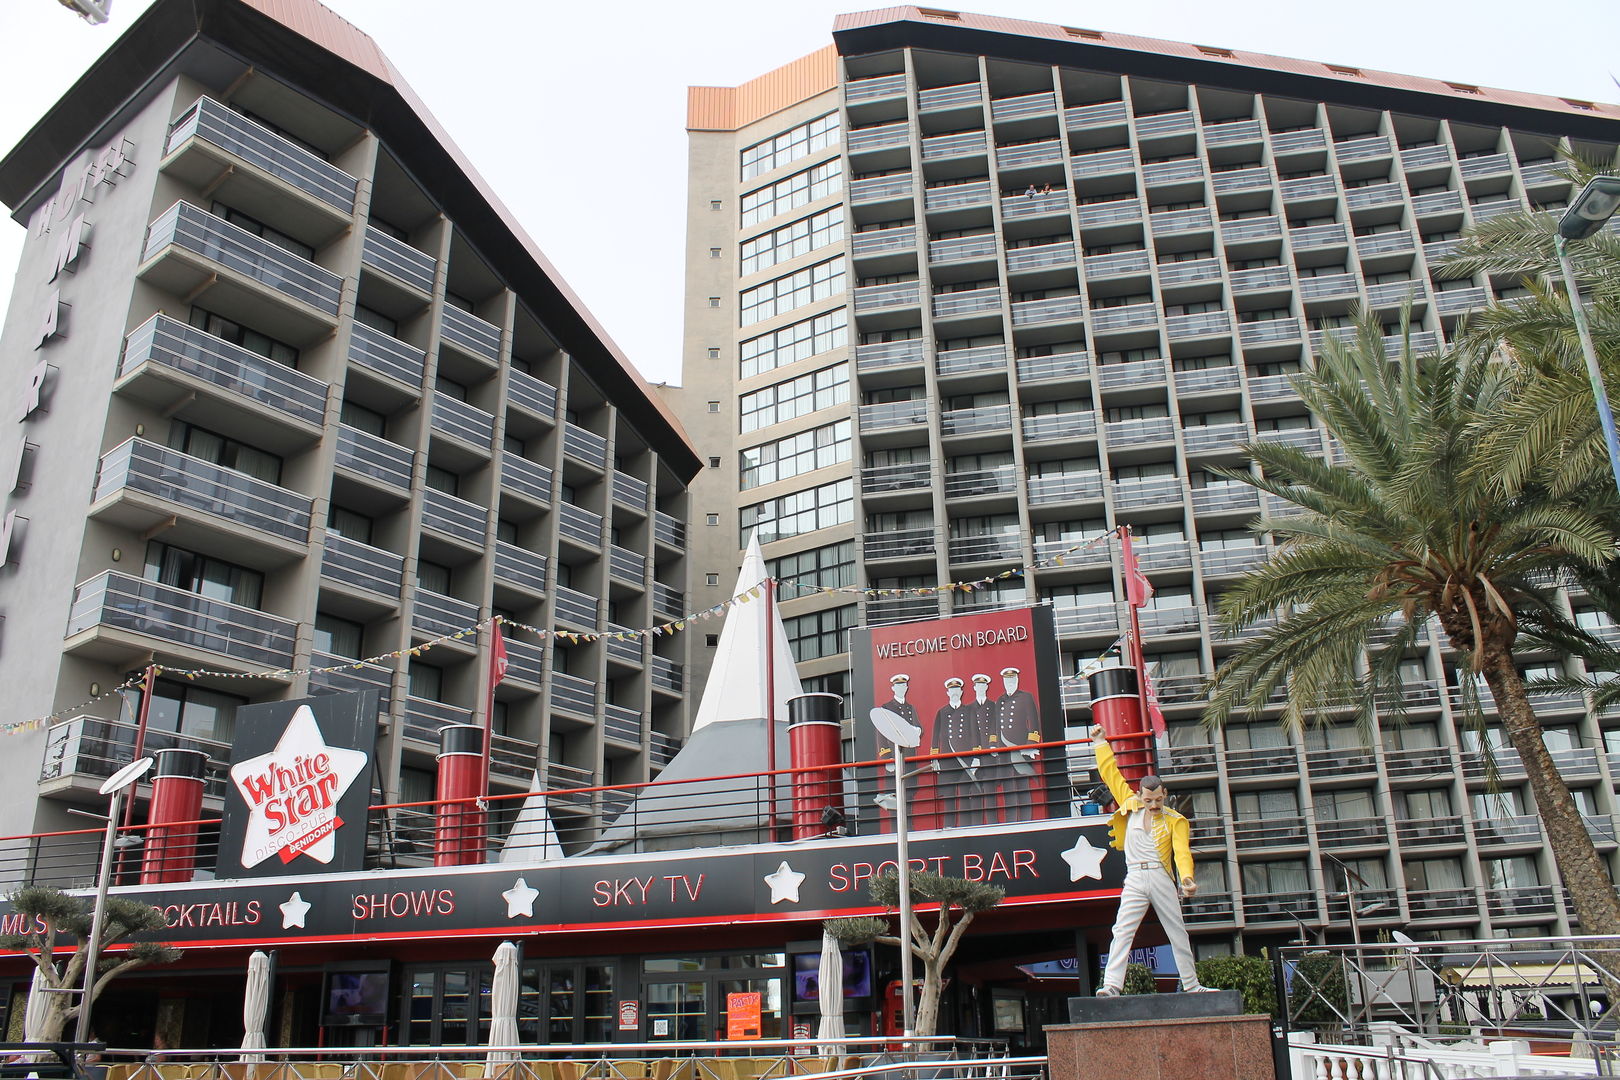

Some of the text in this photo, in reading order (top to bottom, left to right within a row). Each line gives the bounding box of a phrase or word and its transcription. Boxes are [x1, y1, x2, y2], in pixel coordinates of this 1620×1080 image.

[35, 135, 126, 241] HOTEL
[876, 625, 1029, 660] WELCOME ON BOARD
[242, 752, 331, 807] White
[264, 771, 339, 837] Star
[255, 812, 327, 861] DISCO-PUB
[289, 820, 335, 854] BENIDORM
[0, 912, 70, 936] MUS
[351, 889, 456, 920] SHOWS
[592, 875, 655, 907] SKY
[663, 873, 705, 903] TV
[963, 849, 1040, 882] BAR
